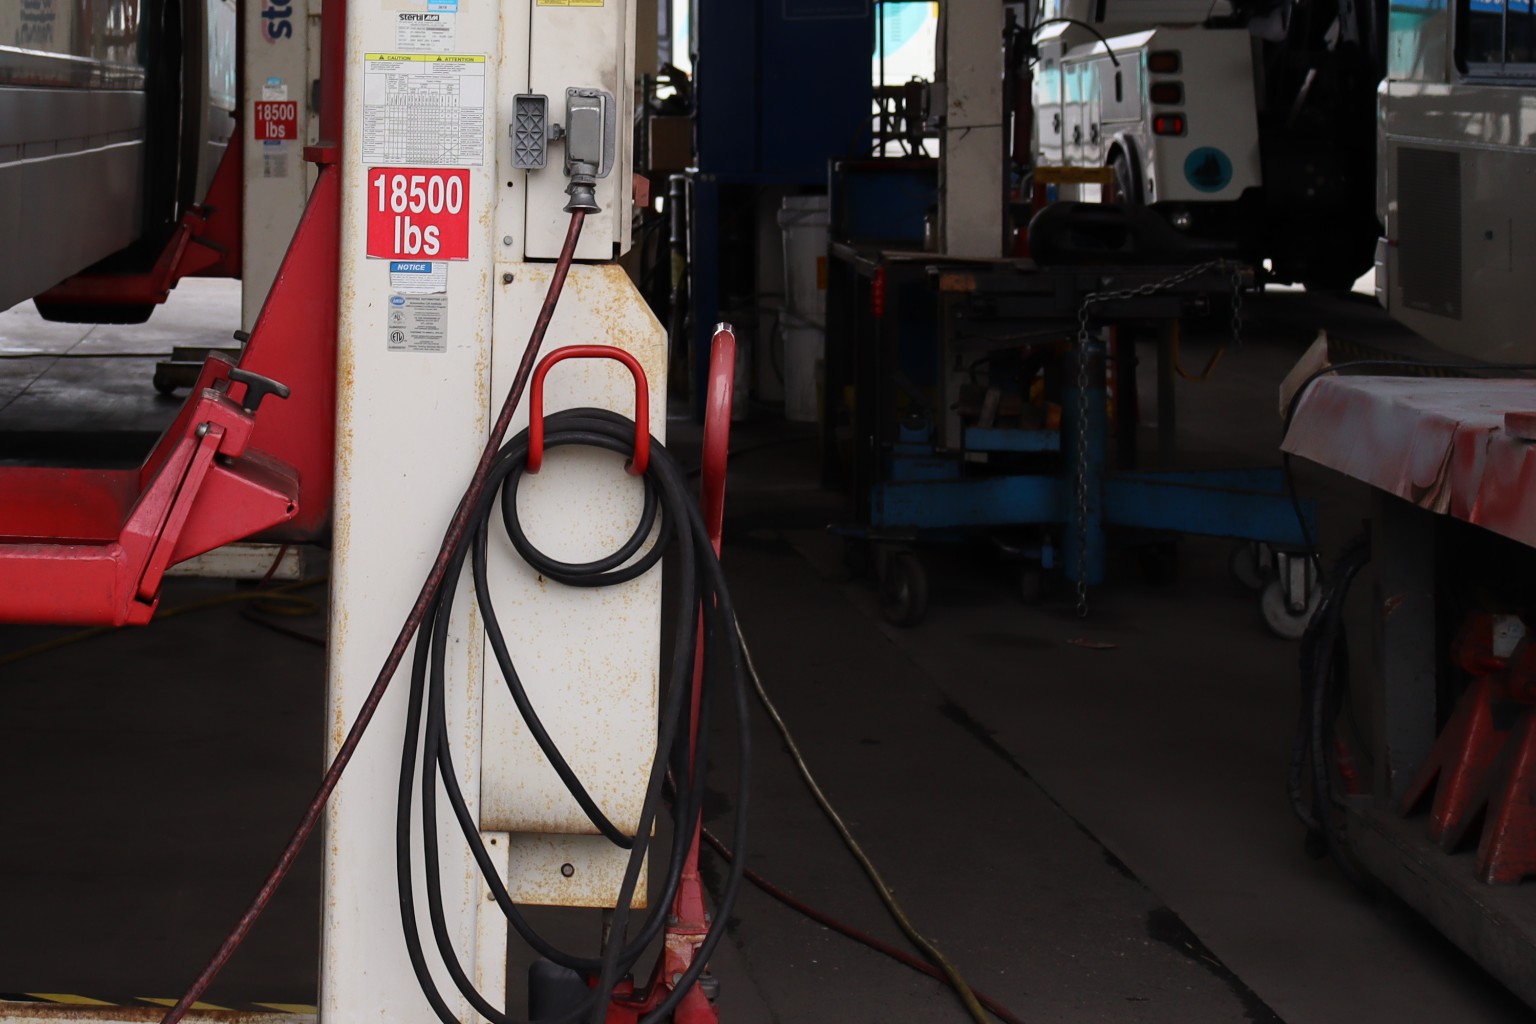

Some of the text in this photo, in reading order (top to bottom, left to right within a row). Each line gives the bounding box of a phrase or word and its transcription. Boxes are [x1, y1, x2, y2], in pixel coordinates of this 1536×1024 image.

[256, 103, 294, 121] 18500
[266, 121, 286, 138] lbs
[373, 175, 463, 215] 18500
[394, 217, 440, 256] lbs
[392, 331, 403, 343] ETL
